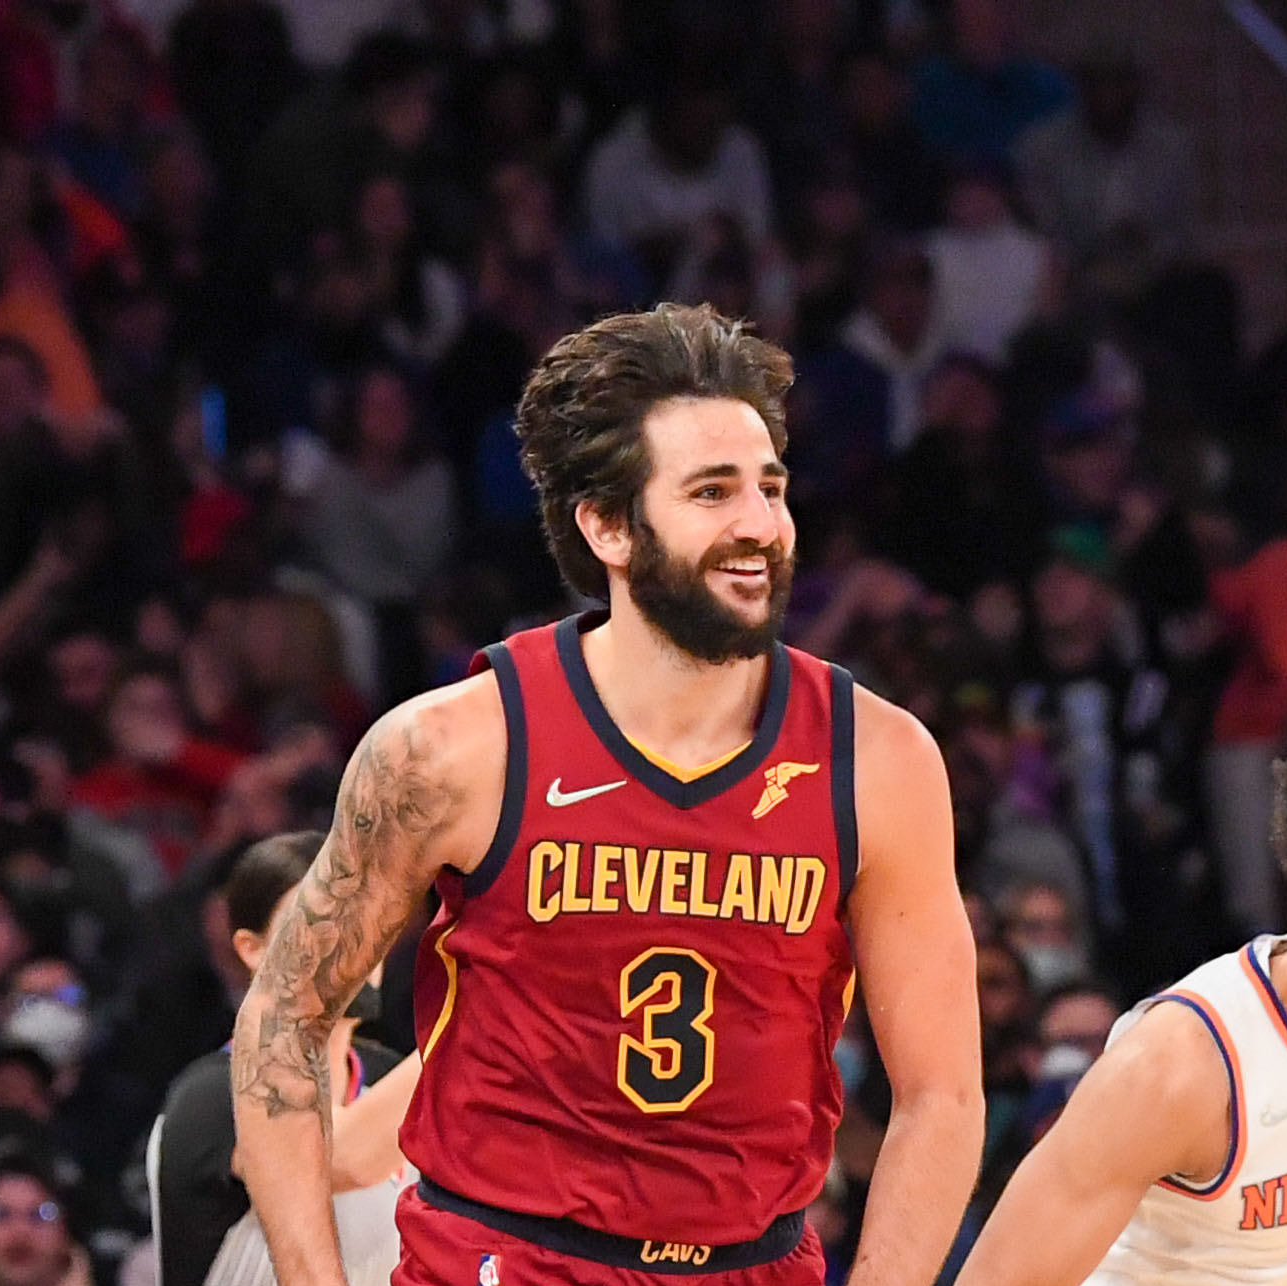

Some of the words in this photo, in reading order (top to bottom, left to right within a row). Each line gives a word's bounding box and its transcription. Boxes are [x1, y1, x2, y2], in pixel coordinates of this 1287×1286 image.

[526, 839, 828, 936] CLEVELAND
[617, 946, 718, 1113] 3
[640, 1240, 712, 1266] CAVS
